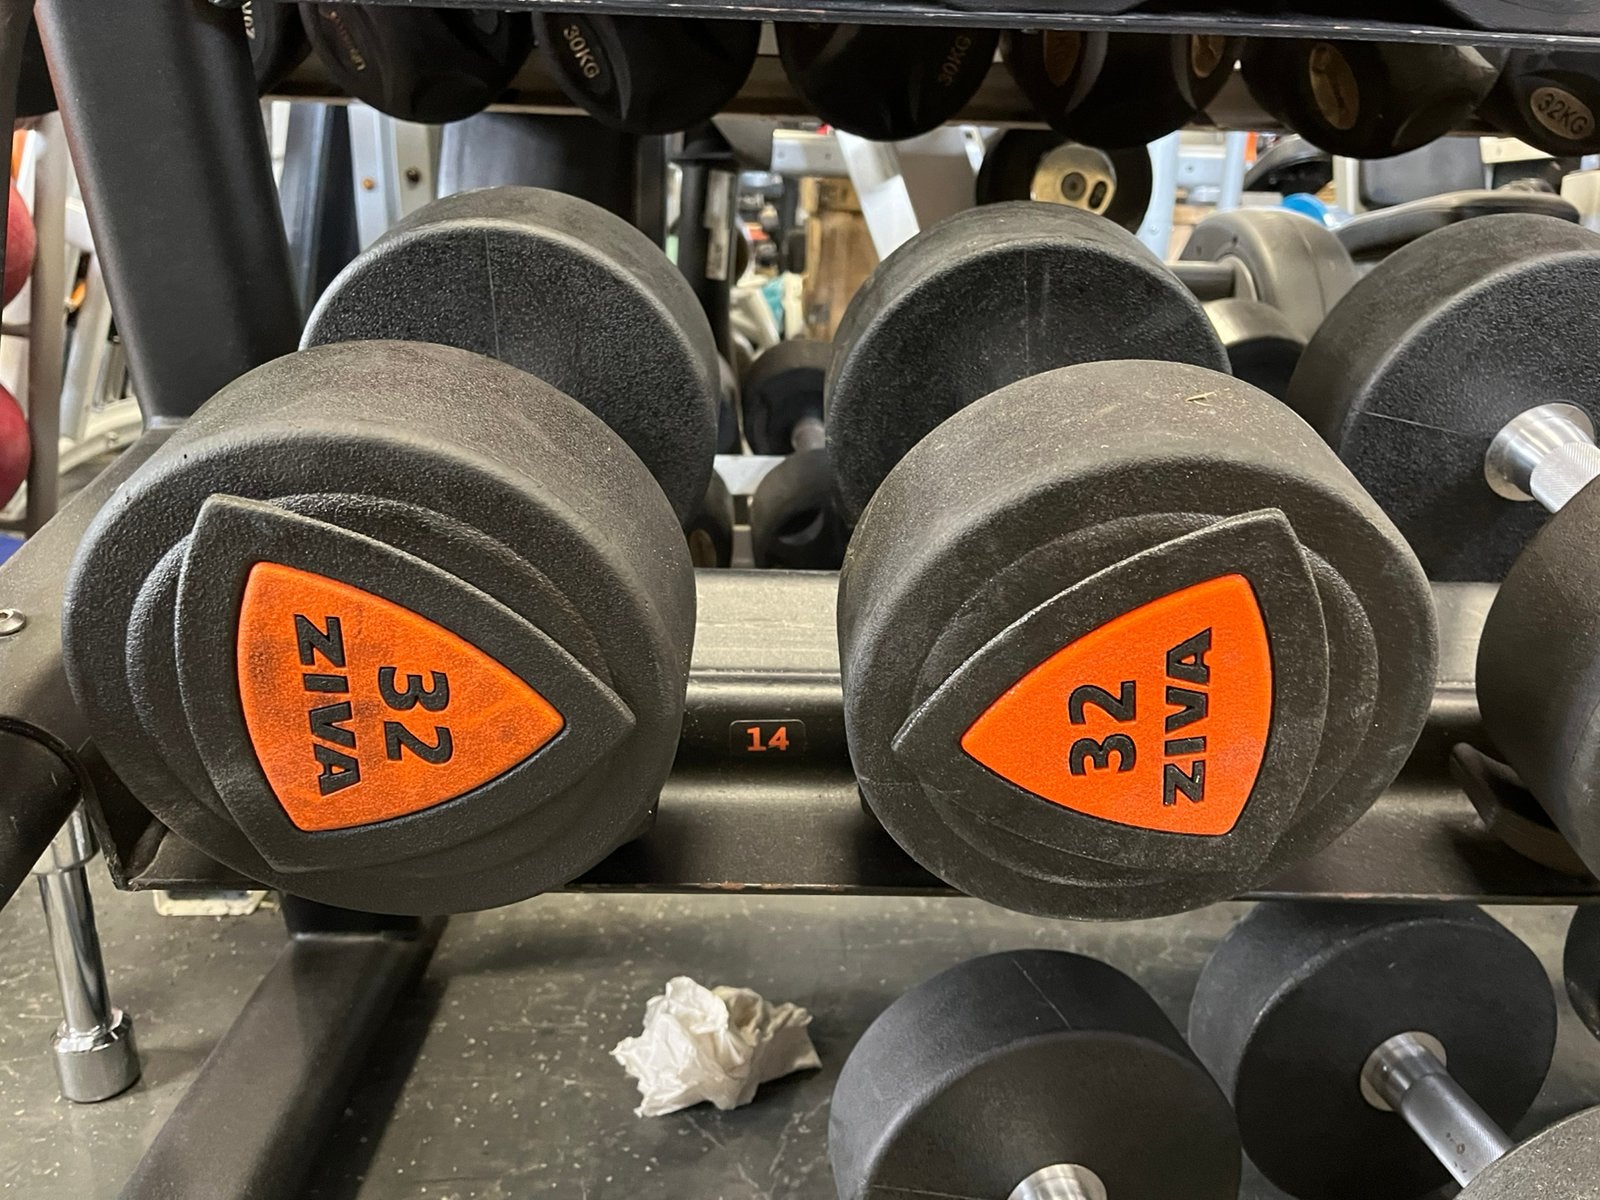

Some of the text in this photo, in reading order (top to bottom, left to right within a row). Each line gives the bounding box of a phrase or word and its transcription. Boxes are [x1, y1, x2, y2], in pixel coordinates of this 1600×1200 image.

[563, 25, 600, 79] 30KG
[1538, 93, 1588, 135] 32KG
[294, 614, 361, 796] ZIVA
[378, 666, 453, 765] 32
[746, 726, 790, 752] 14
[1068, 680, 1137, 776] 32
[1163, 626, 1213, 807] ZIVA
